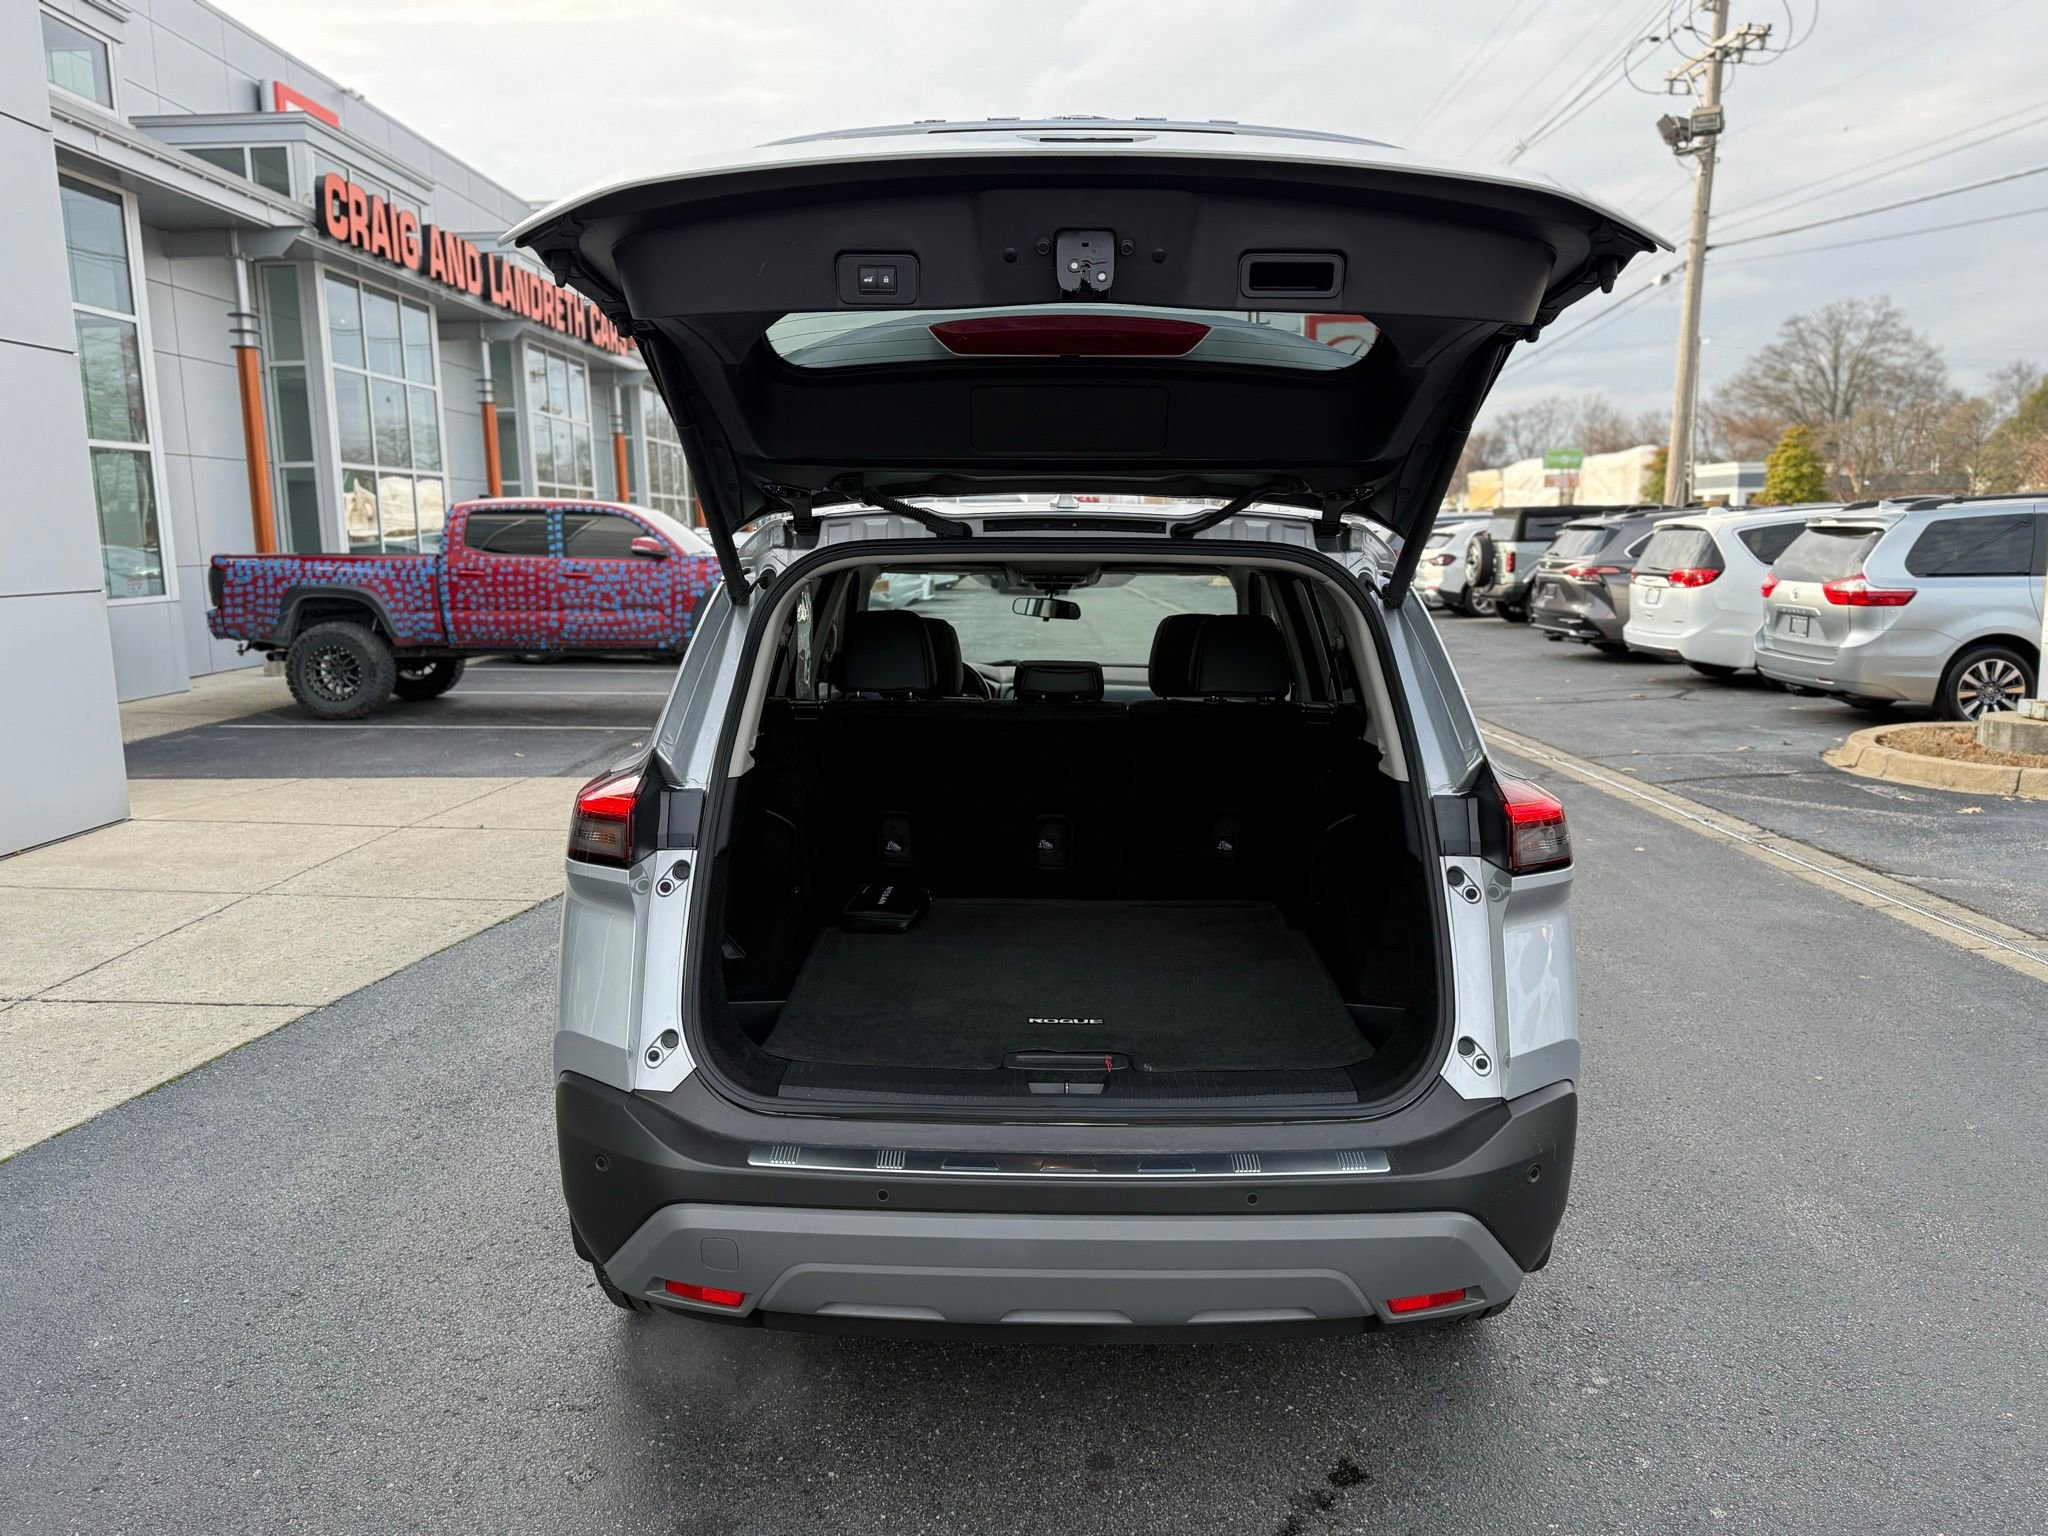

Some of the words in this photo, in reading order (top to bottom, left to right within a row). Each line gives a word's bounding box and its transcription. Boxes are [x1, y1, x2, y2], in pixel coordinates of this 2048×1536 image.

[323, 172, 421, 272] CRAIG
[429, 223, 483, 297] AND
[487, 252, 586, 340] LANDRETH
